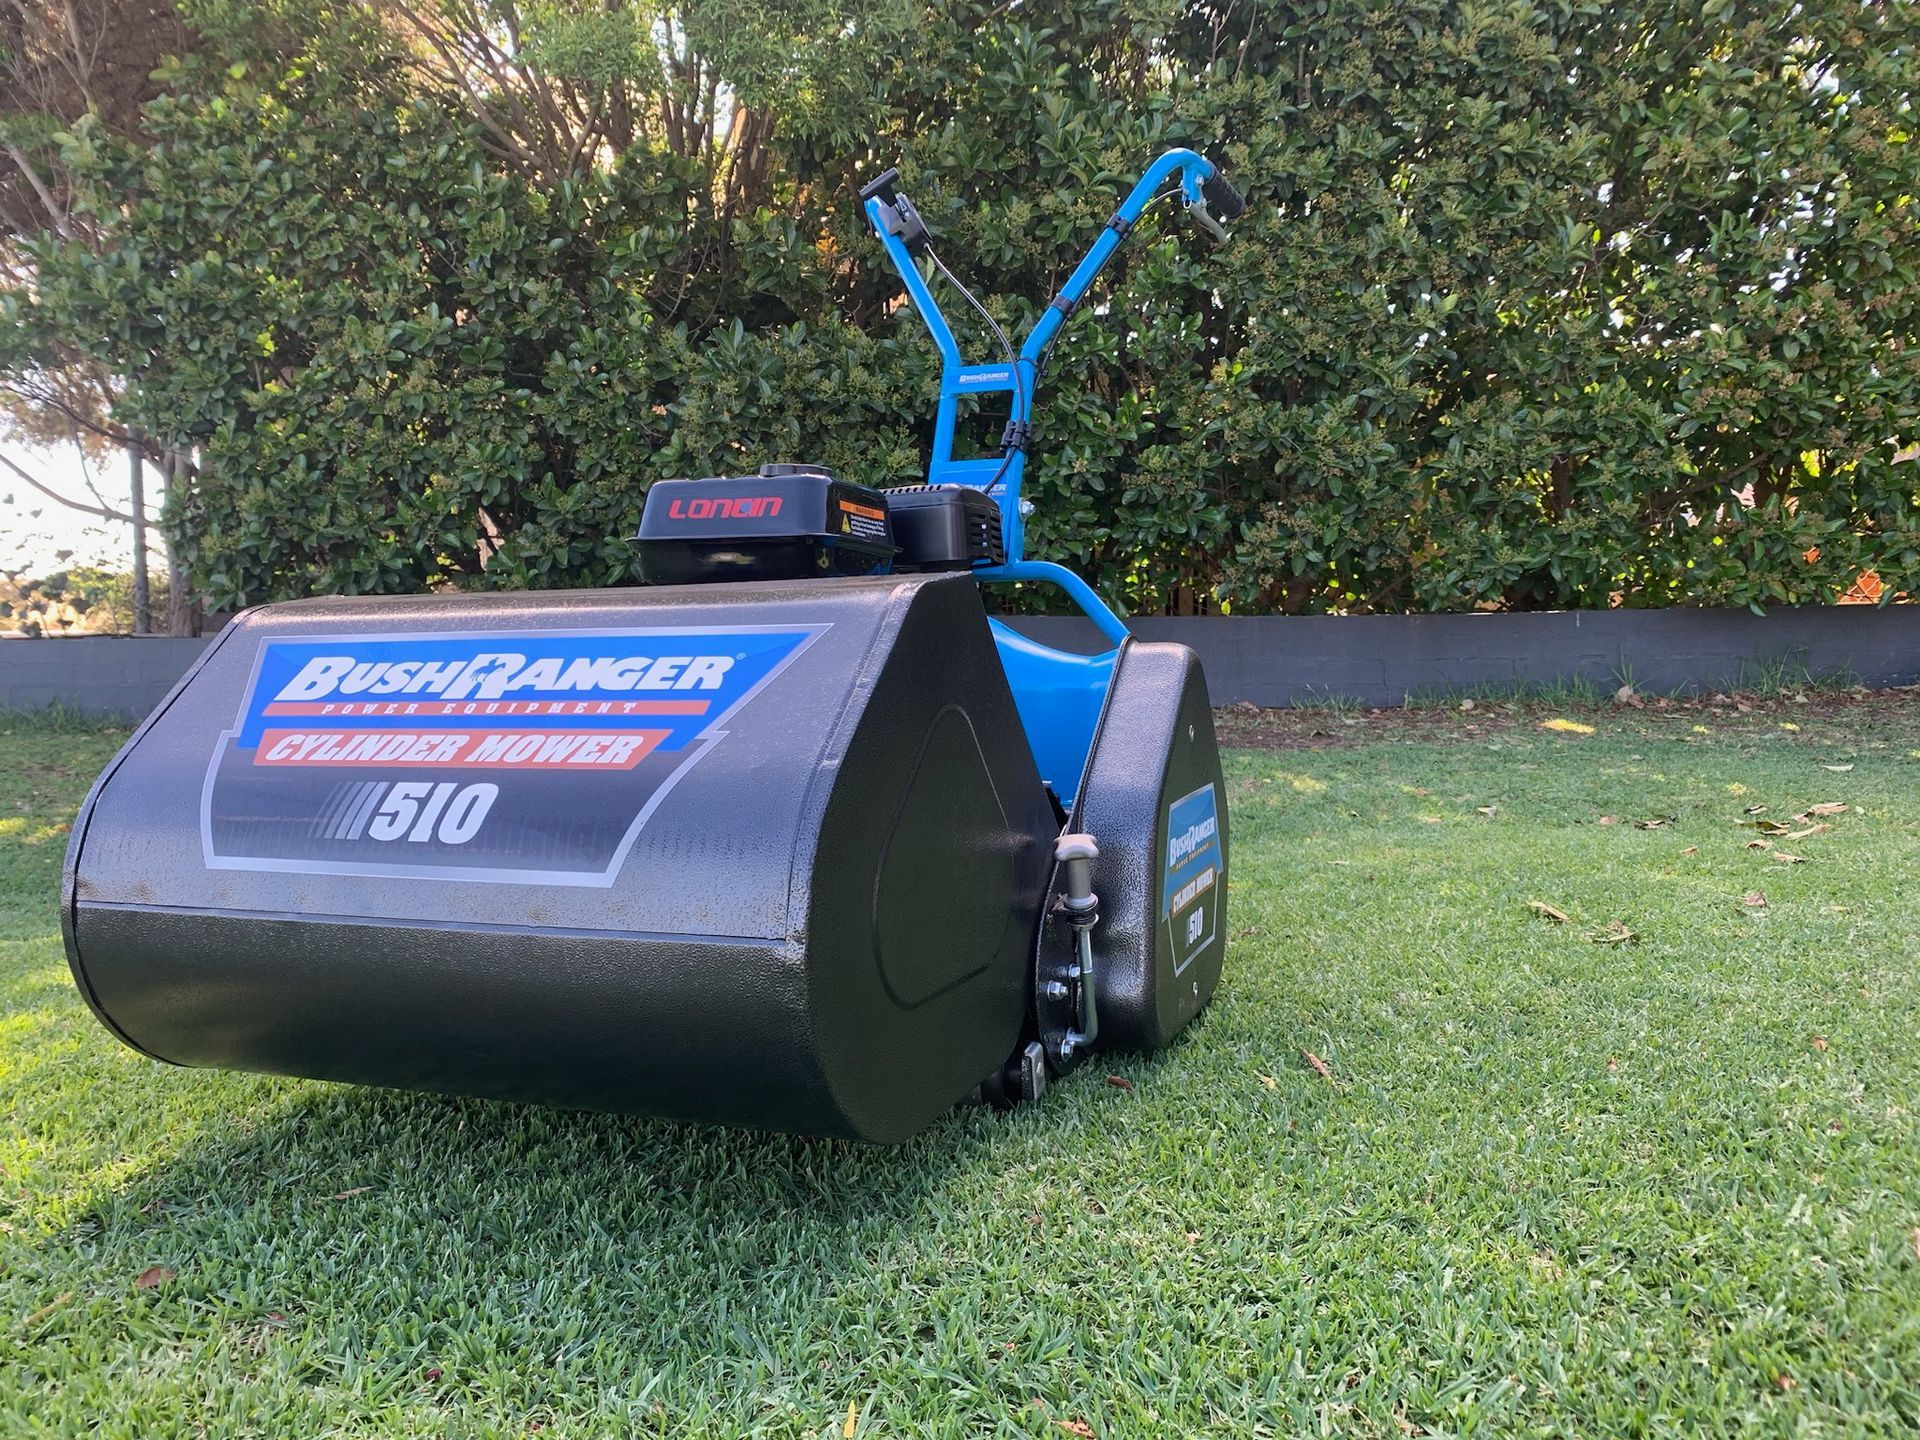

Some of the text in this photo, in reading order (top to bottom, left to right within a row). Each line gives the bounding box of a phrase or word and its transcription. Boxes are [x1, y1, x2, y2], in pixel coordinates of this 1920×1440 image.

[273, 653, 735, 701] BUSHRANGER
[321, 703, 637, 715] POWER EQUIPMENT
[265, 734, 644, 764] CYLINDER MOWER
[367, 782, 500, 844] 510
[1189, 906, 1204, 945] 510
